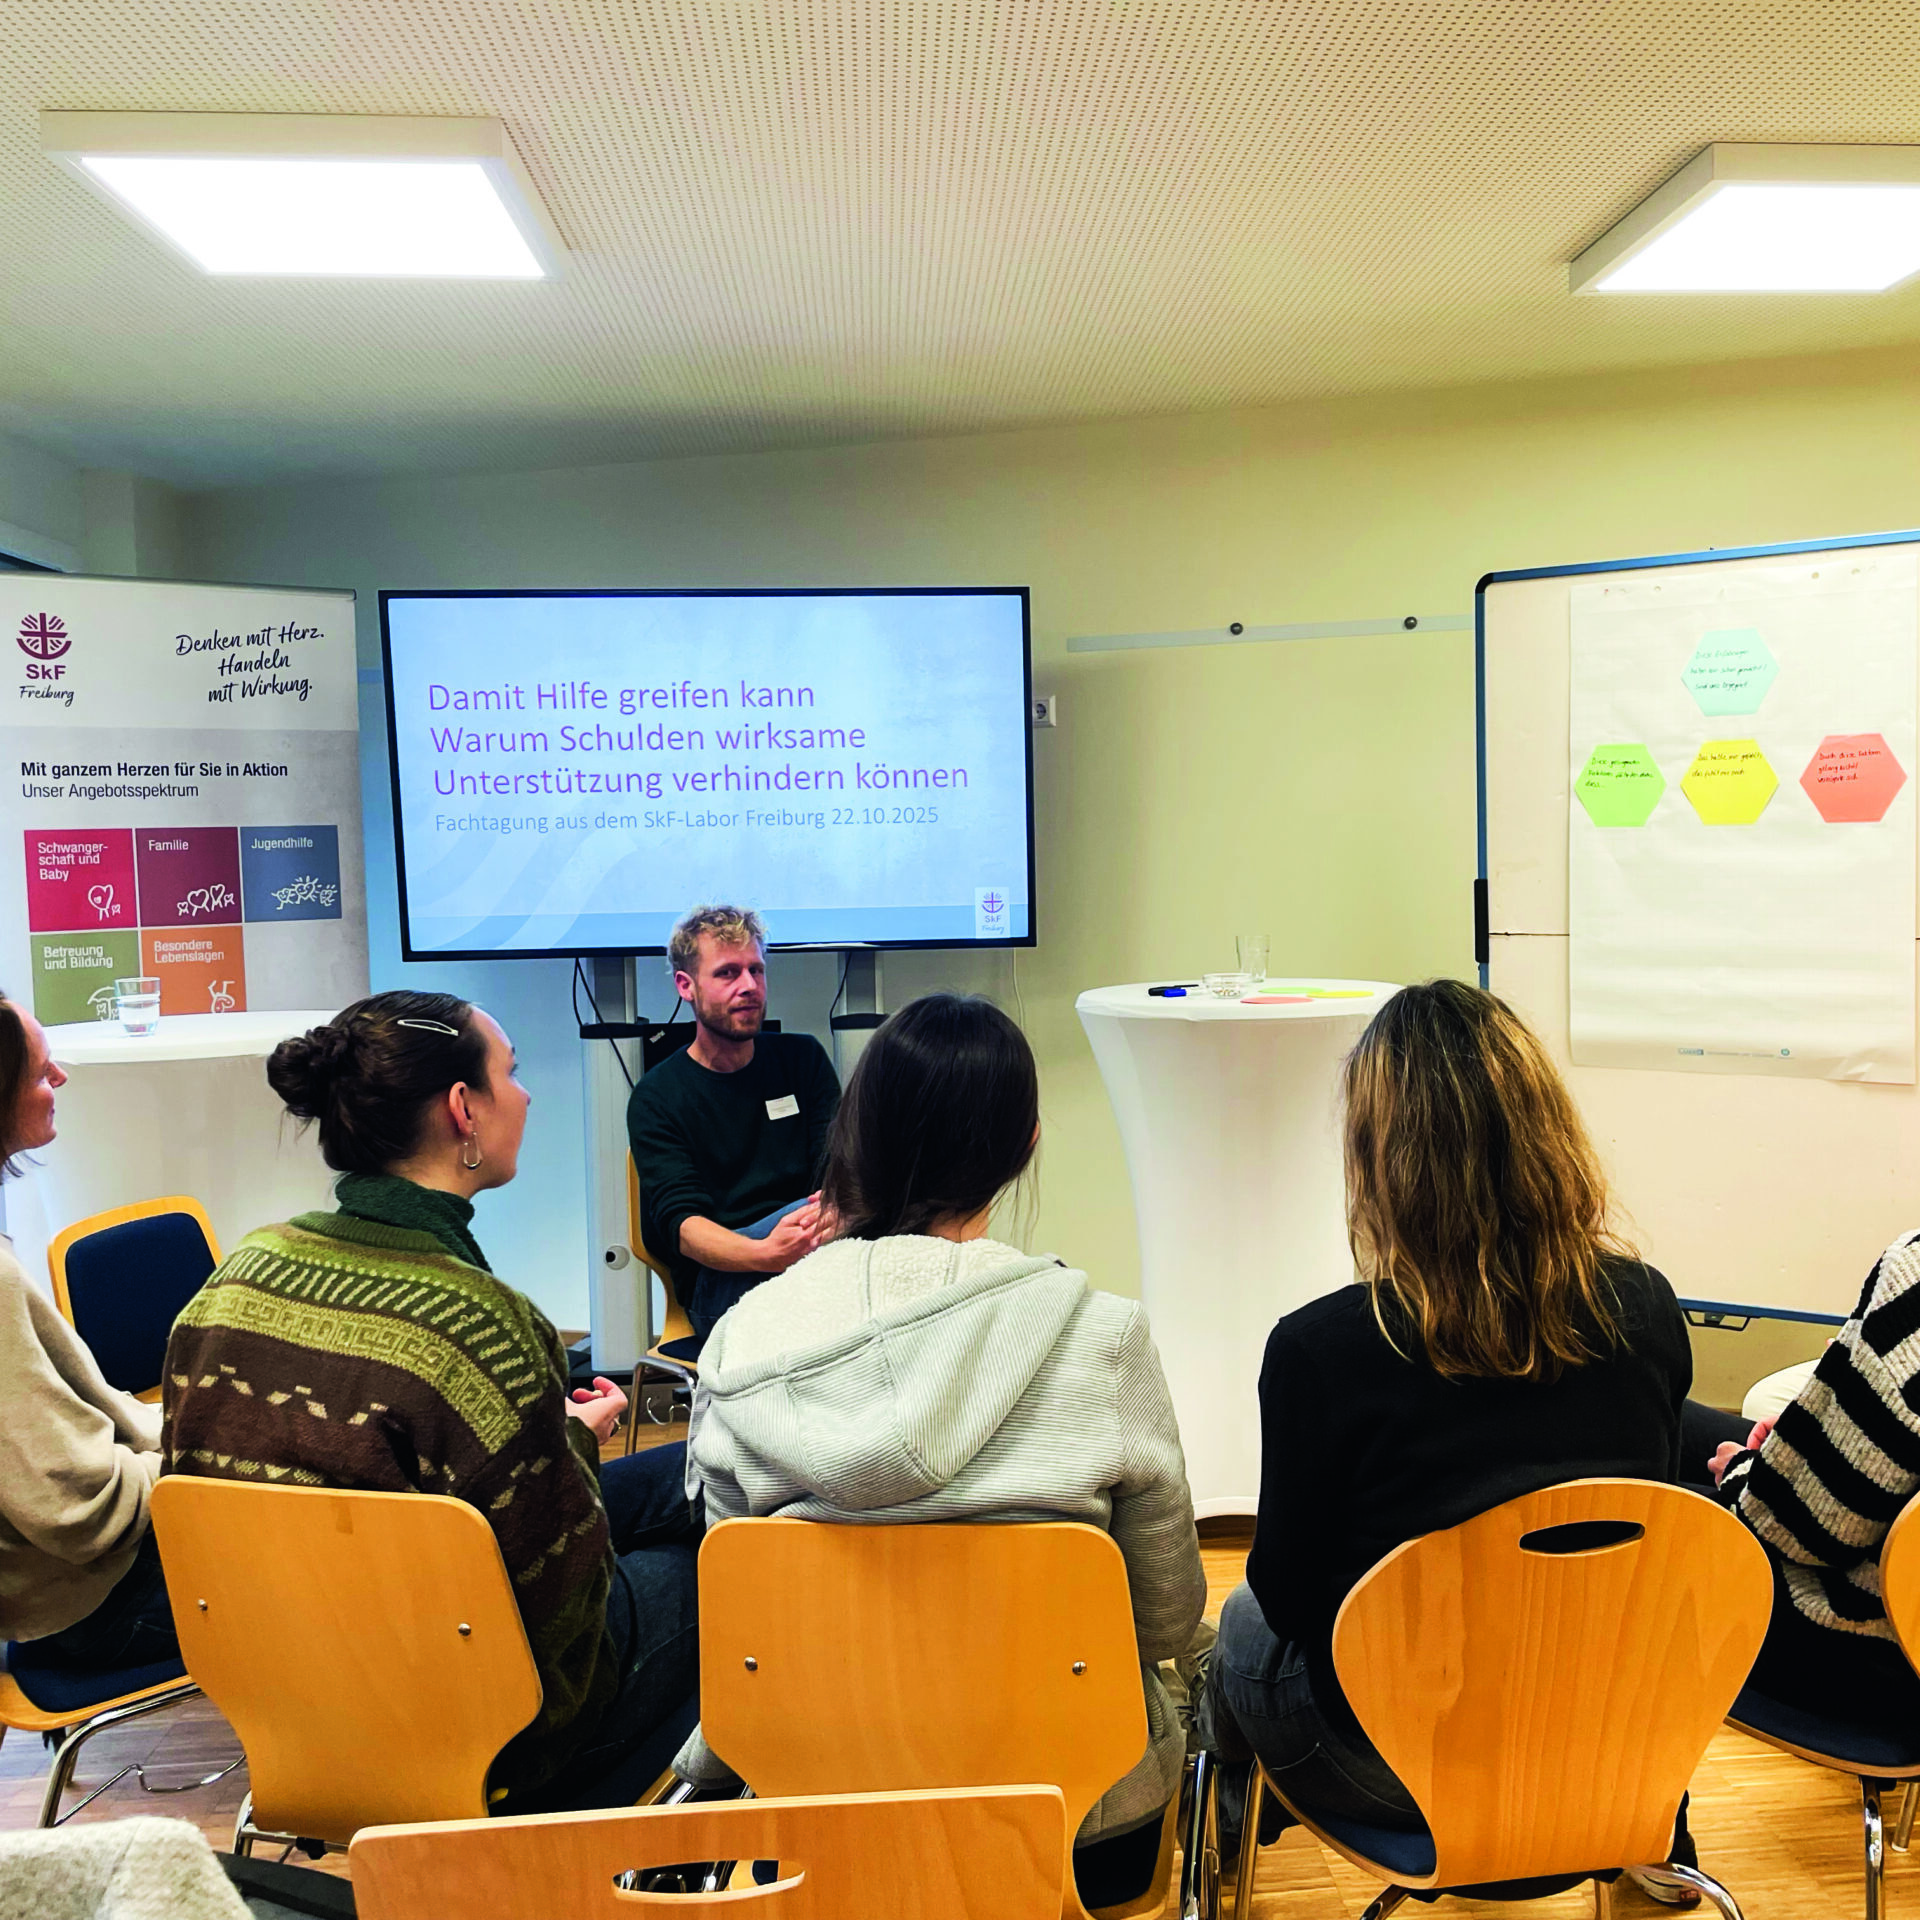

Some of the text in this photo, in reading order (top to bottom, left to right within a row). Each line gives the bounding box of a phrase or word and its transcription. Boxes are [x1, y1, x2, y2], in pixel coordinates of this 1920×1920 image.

[176, 622, 325, 655] Denken mit Herz.
[218, 649, 290, 677] Handeln
[26, 664, 66, 680] SkF
[19, 685, 74, 707] Freiburg
[208, 677, 313, 702] mit Wirkung.
[429, 679, 815, 715] Damit Hilfe greifen kann
[430, 721, 866, 753] Warum Schulden wirksame
[21, 762, 288, 780] Mit ganzem Herzen für Sie in Aktion
[434, 761, 968, 799] Unterstützung verhindern können
[22, 784, 199, 800] Unser Angebotsspektrum
[435, 807, 939, 834] Fachtagung aus dem SkF-Labor Freiburg 22.10.2025
[38, 842, 108, 855] Schwanger-
[148, 839, 189, 851] Familie
[251, 838, 314, 850] Jugendhilfe
[39, 853, 100, 866] schaft und
[39, 868, 69, 882] Baby
[44, 945, 104, 960] Betreuung
[154, 939, 213, 952] Besondere
[44, 955, 114, 970] und Bildung
[154, 950, 225, 964] Lebenslagen
